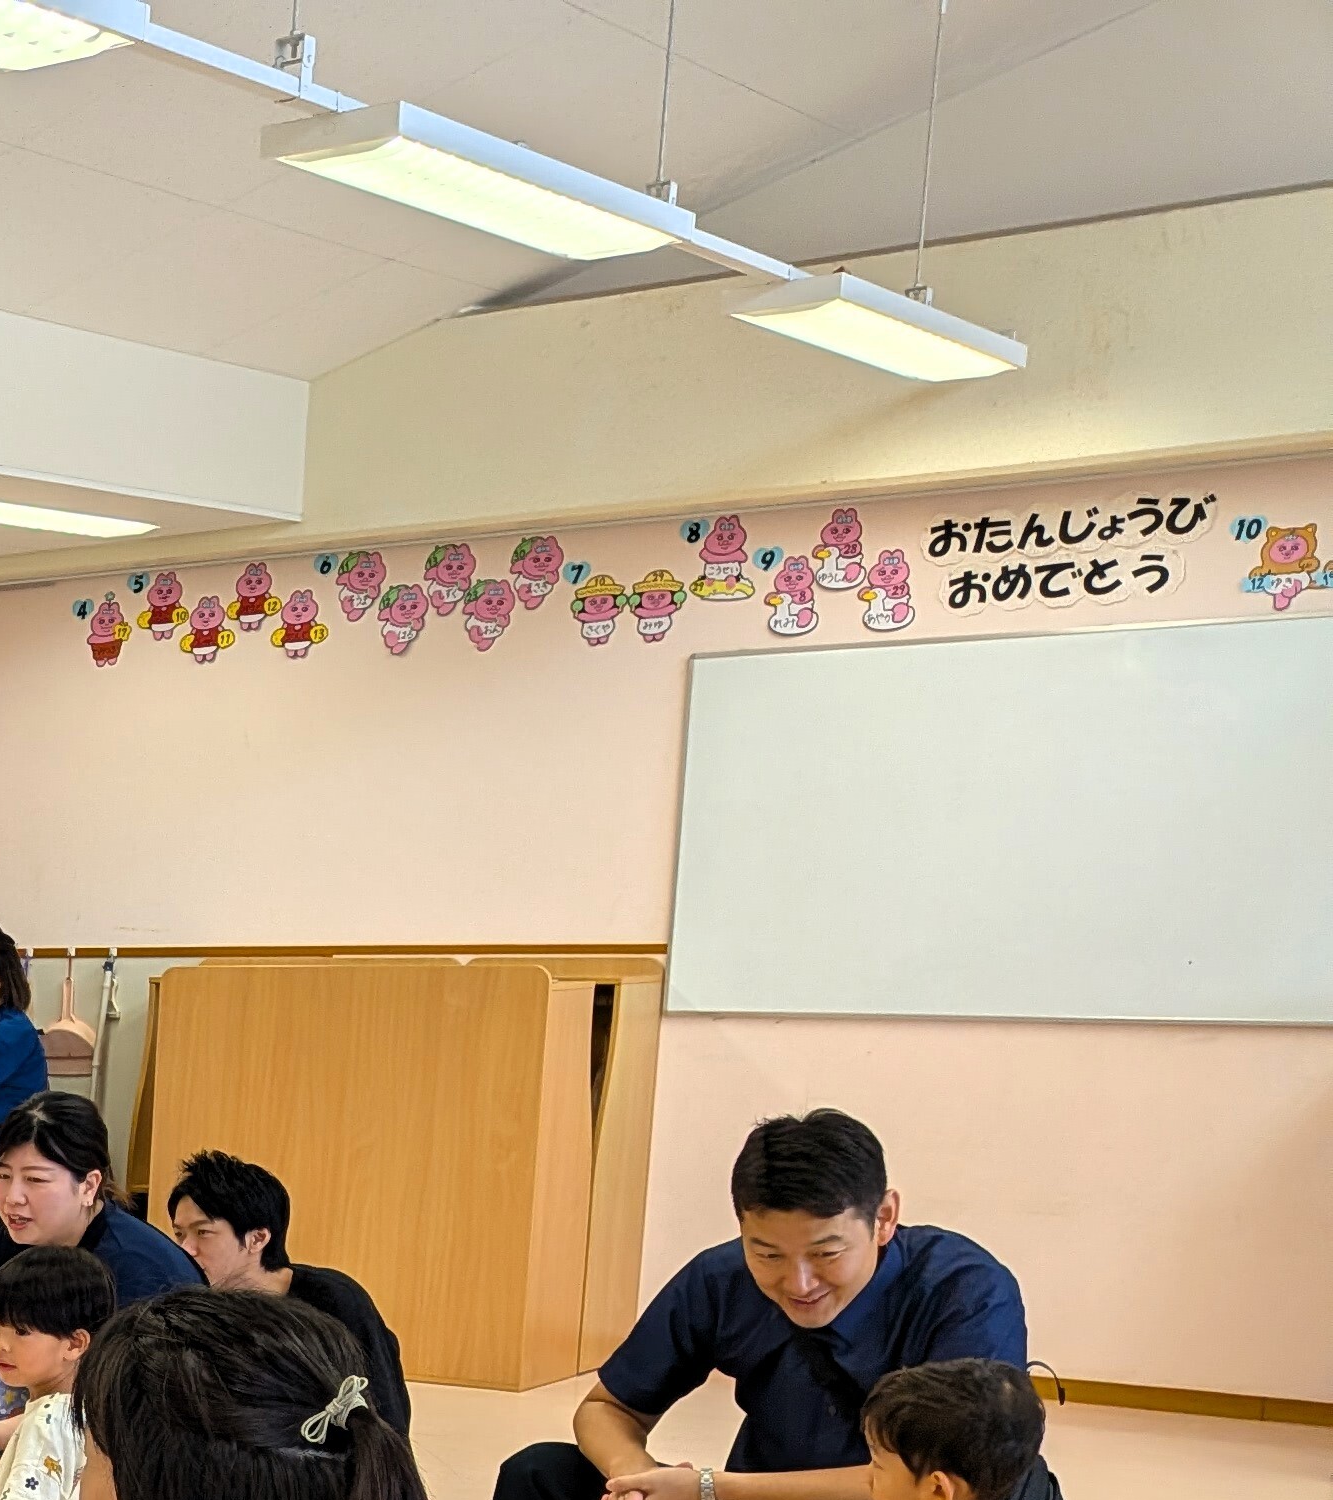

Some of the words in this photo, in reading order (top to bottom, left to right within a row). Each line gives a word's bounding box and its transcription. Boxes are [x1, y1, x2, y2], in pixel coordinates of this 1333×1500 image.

[687, 522, 700, 543] 8
[928, 494, 1217, 557] おたんじょうび
[1235, 519, 1262, 540] 10
[320, 556, 332, 574] 6
[761, 550, 775, 571] 9
[133, 575, 144, 593] 5
[571, 564, 584, 585] 7
[948, 554, 1170, 609] おめでとう
[1251, 578, 1264, 590] 12
[77, 601, 87, 619] 4
